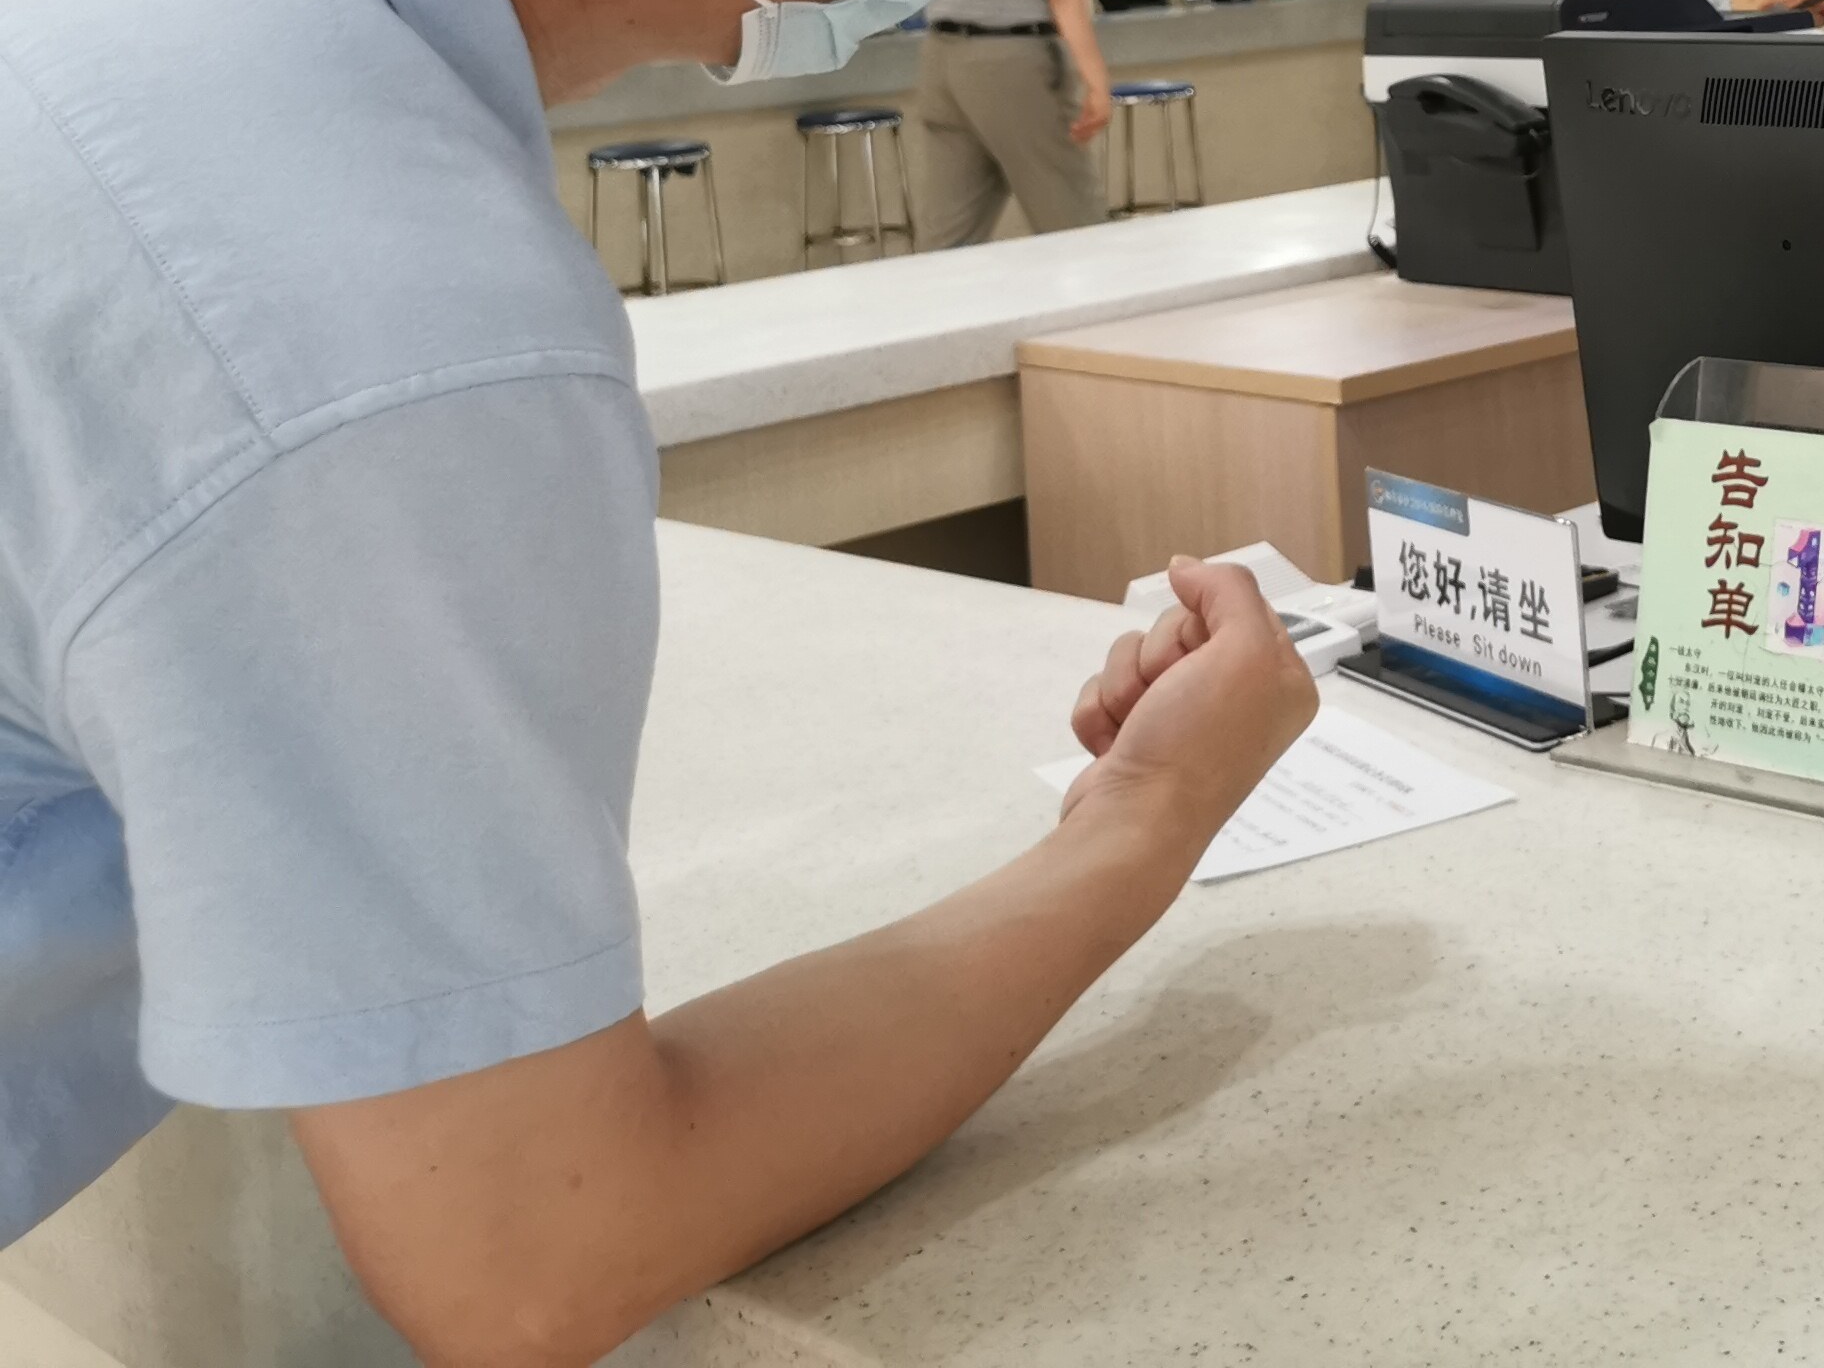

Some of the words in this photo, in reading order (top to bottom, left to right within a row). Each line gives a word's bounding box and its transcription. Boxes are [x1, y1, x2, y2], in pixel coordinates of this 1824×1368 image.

[1585, 79, 1692, 121] Lenovo
[1700, 444, 1771, 643] 告知单
[1413, 614, 1462, 648] Please
[1473, 633, 1495, 661] Sit
[1499, 646, 1543, 678] down
